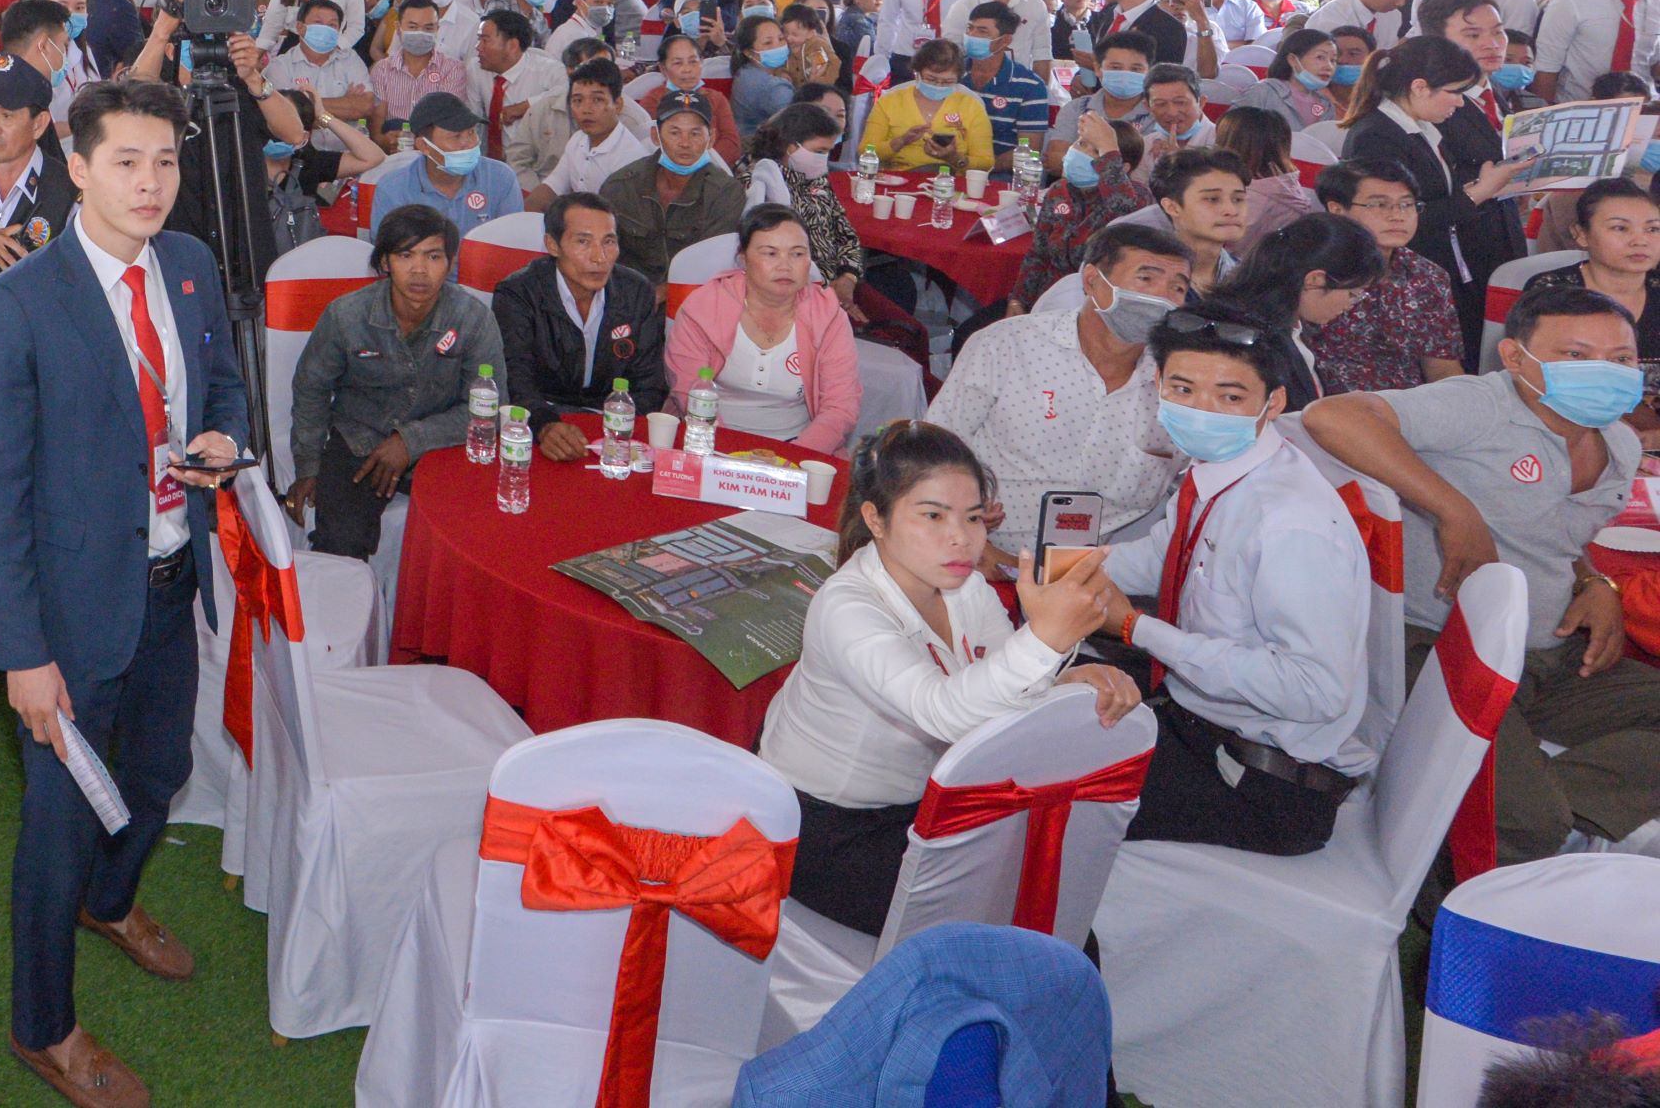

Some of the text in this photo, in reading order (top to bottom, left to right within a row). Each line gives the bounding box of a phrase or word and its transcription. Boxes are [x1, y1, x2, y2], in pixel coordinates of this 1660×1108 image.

[755, 476, 777, 485] GIAO
[718, 481, 741, 492] KIM
[743, 484, 768, 497] TÂM
[158, 494, 172, 505] GIAO
